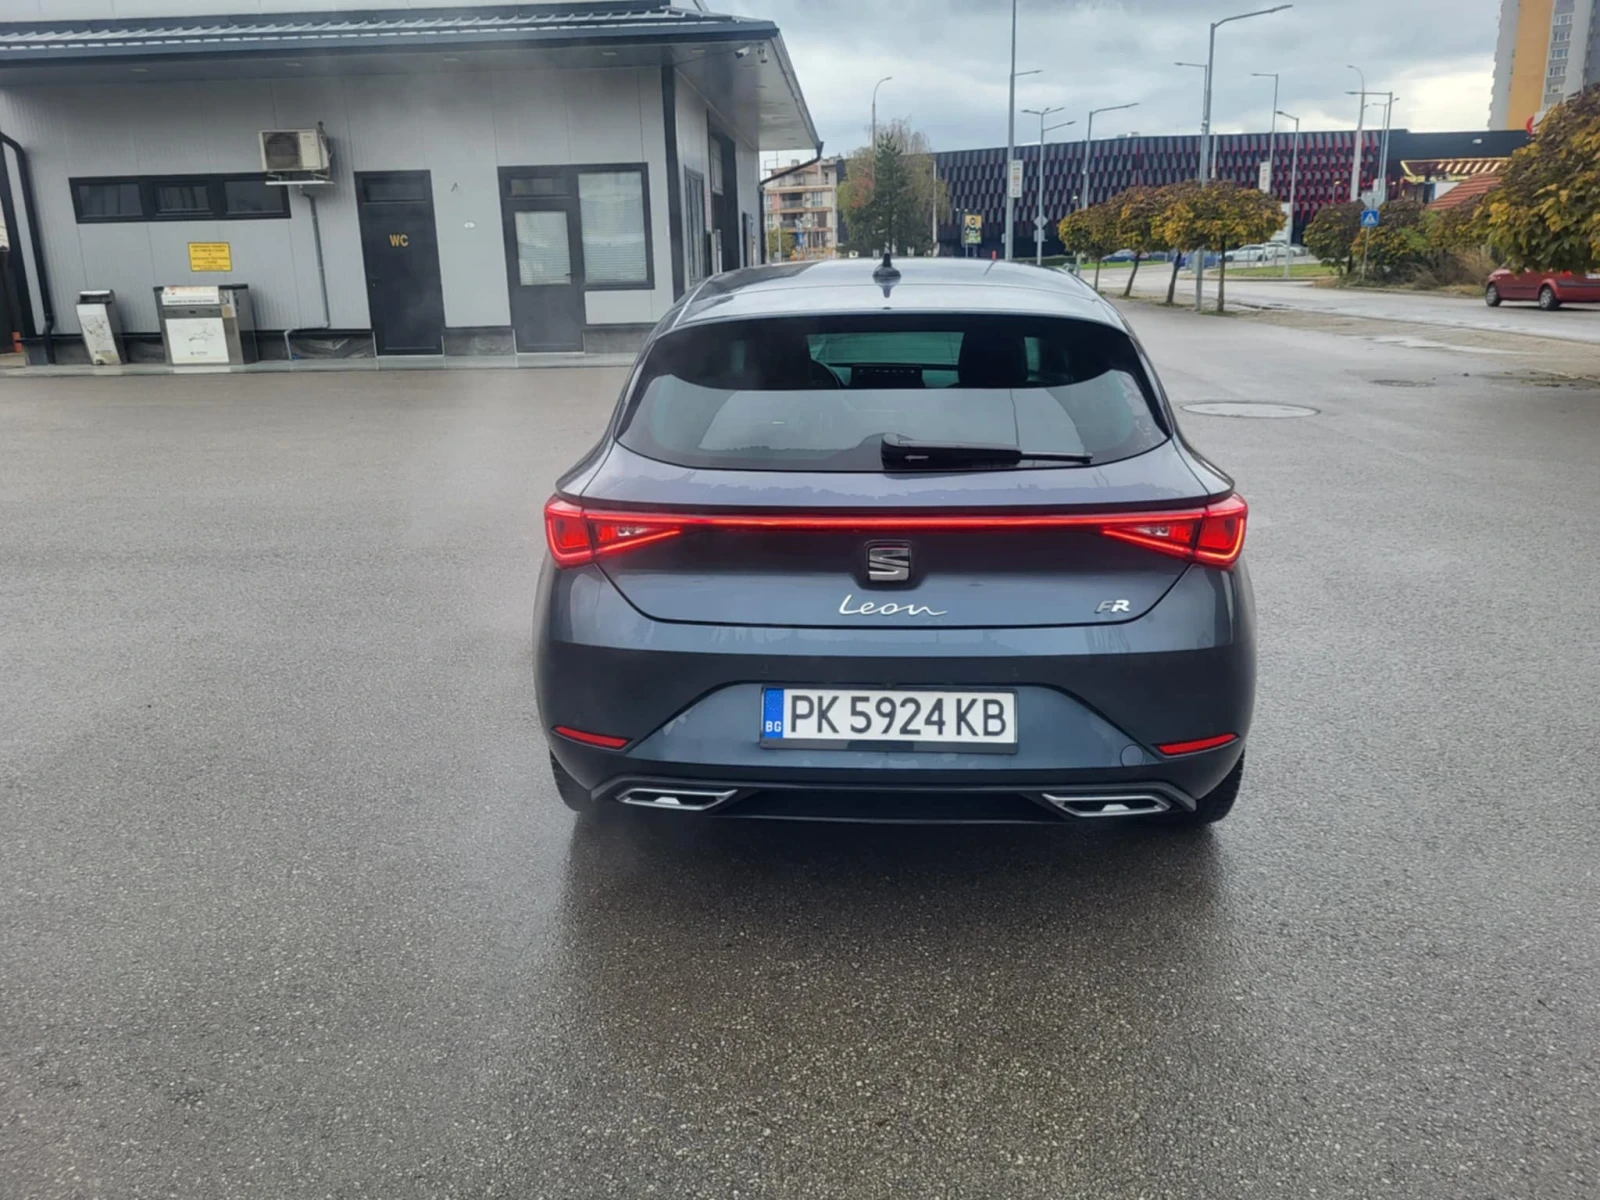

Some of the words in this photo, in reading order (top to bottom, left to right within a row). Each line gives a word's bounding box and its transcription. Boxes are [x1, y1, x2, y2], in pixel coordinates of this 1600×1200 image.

[389, 234, 409, 247] WC
[839, 594, 948, 616] Leon
[1094, 599, 1130, 614] FR
[790, 695, 840, 734] PK
[850, 696, 946, 736] 5924
[956, 698, 1007, 737] KB
[765, 720, 782, 733] BG
